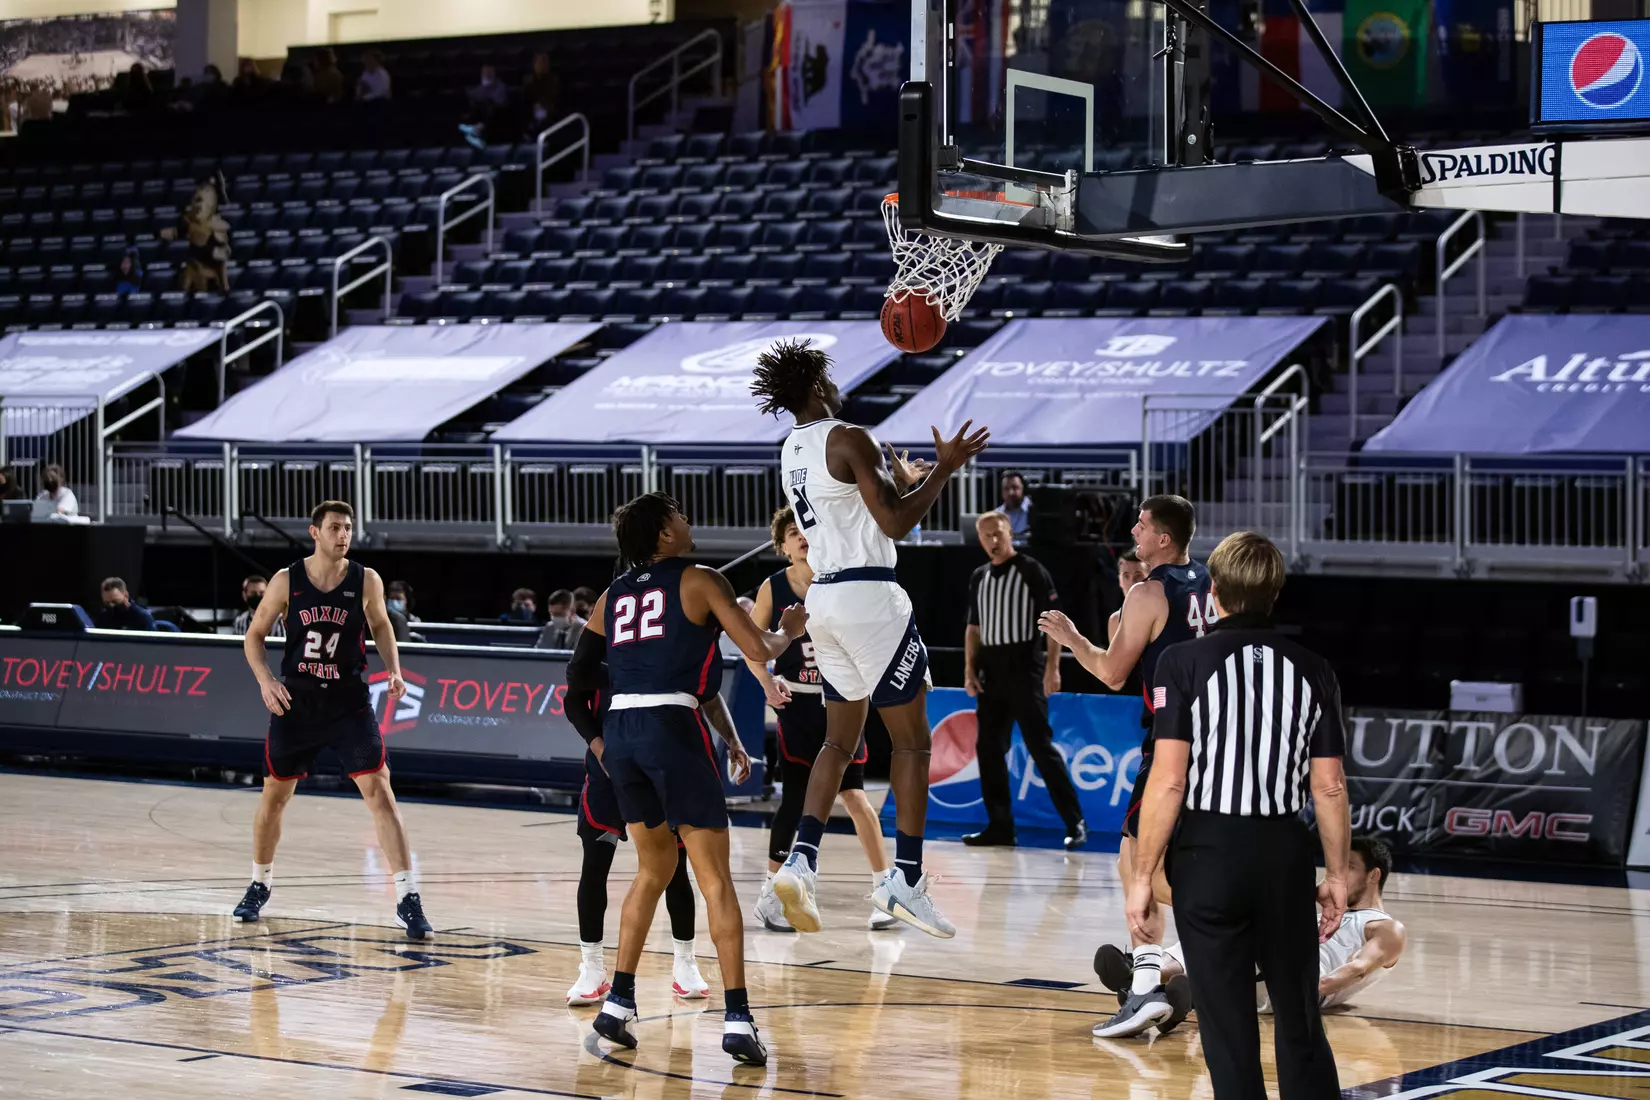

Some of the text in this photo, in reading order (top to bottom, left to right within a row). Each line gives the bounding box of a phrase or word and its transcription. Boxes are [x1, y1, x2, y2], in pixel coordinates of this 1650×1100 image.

[1421, 145, 1555, 185] SPALDING
[972, 360, 1248, 378] TOVEY/SHULTZ
[299, 605, 349, 626] DIXIE
[612, 587, 666, 647] 22
[1187, 591, 1220, 638] 44
[303, 630, 340, 659] 24
[889, 637, 920, 690] LANCERS
[3, 657, 212, 697] TOVEY/SHULTZ
[298, 662, 340, 680] STATE
[1444, 806, 1594, 842] GMC
